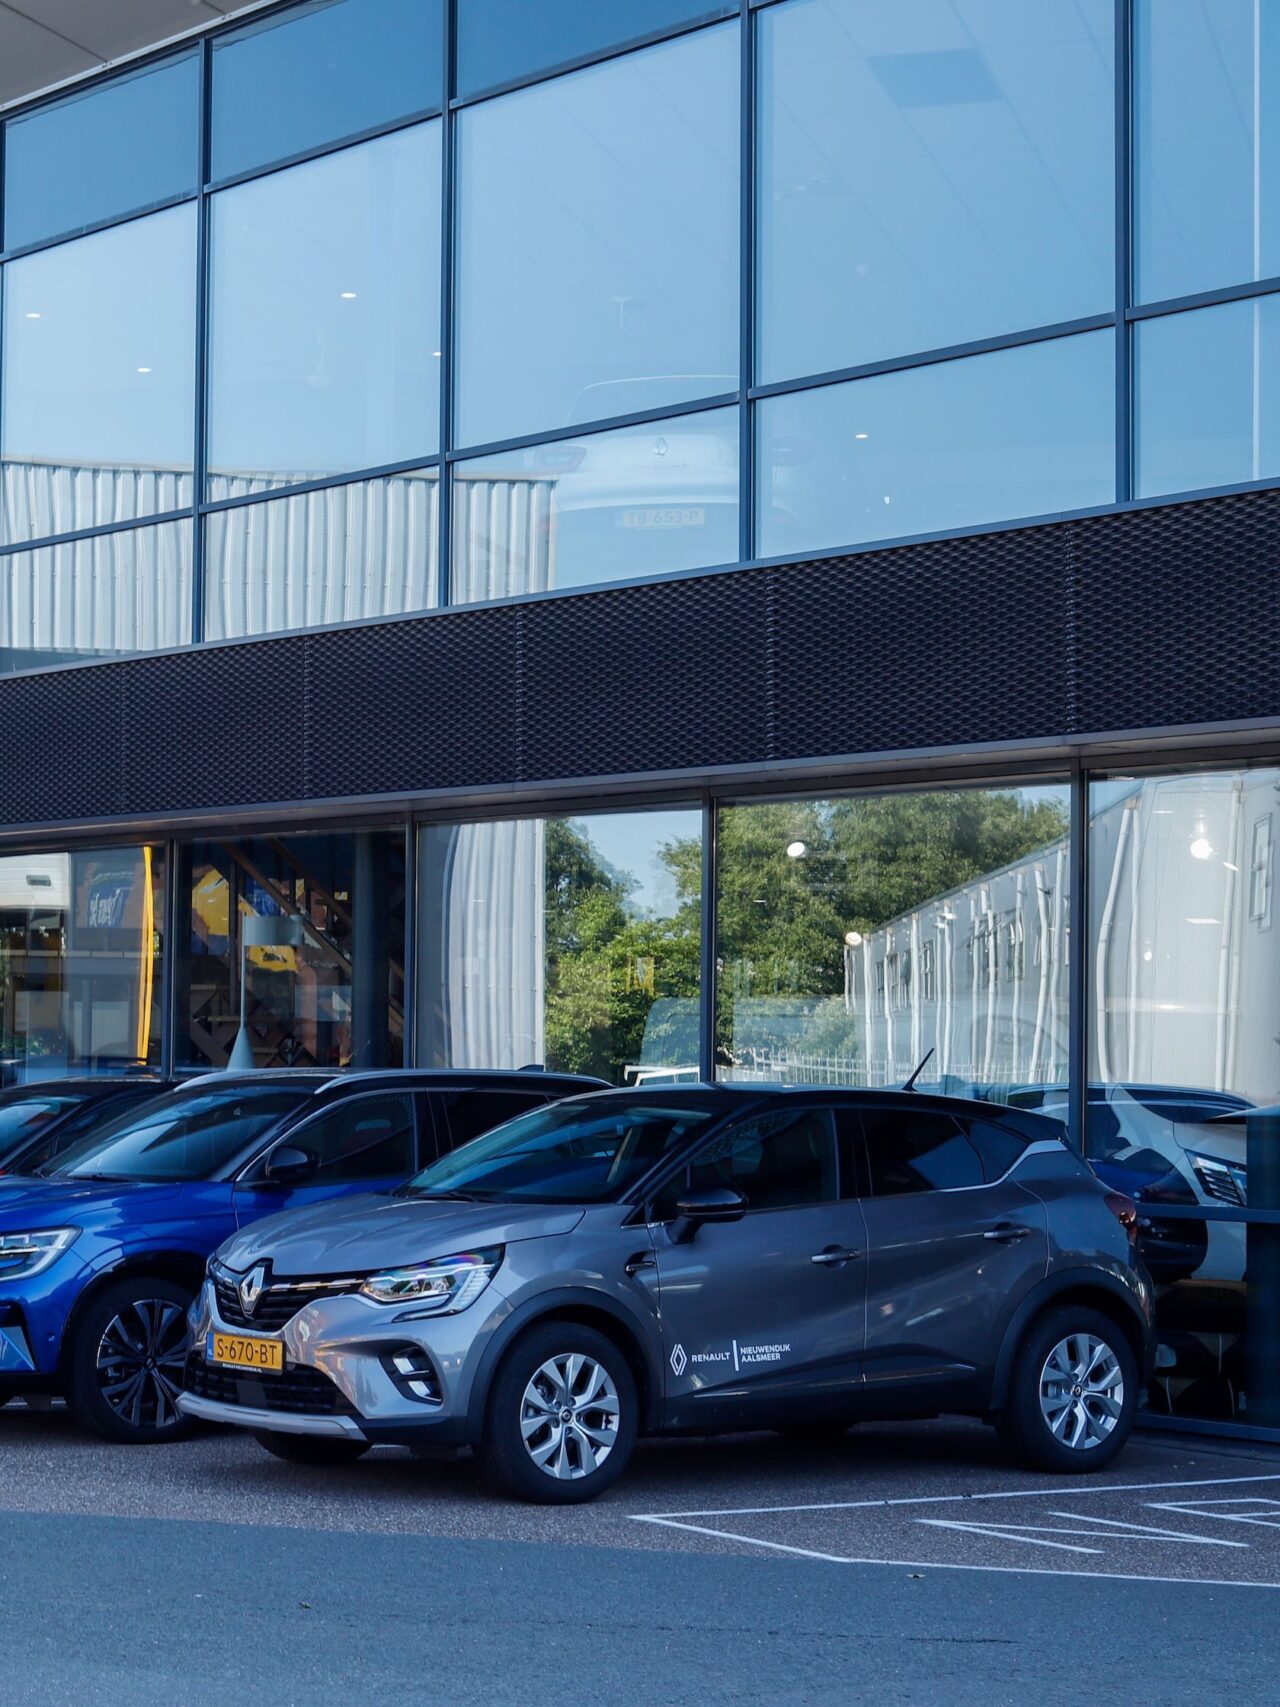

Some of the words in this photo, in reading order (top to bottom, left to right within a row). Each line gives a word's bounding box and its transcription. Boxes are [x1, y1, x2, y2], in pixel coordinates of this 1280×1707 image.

[217, 1338, 277, 1365] S-670-BT
[740, 1344, 791, 1355] NIEUWENDIJK
[691, 1352, 731, 1363] RENAULT
[741, 1353, 781, 1363] AALSMEER
